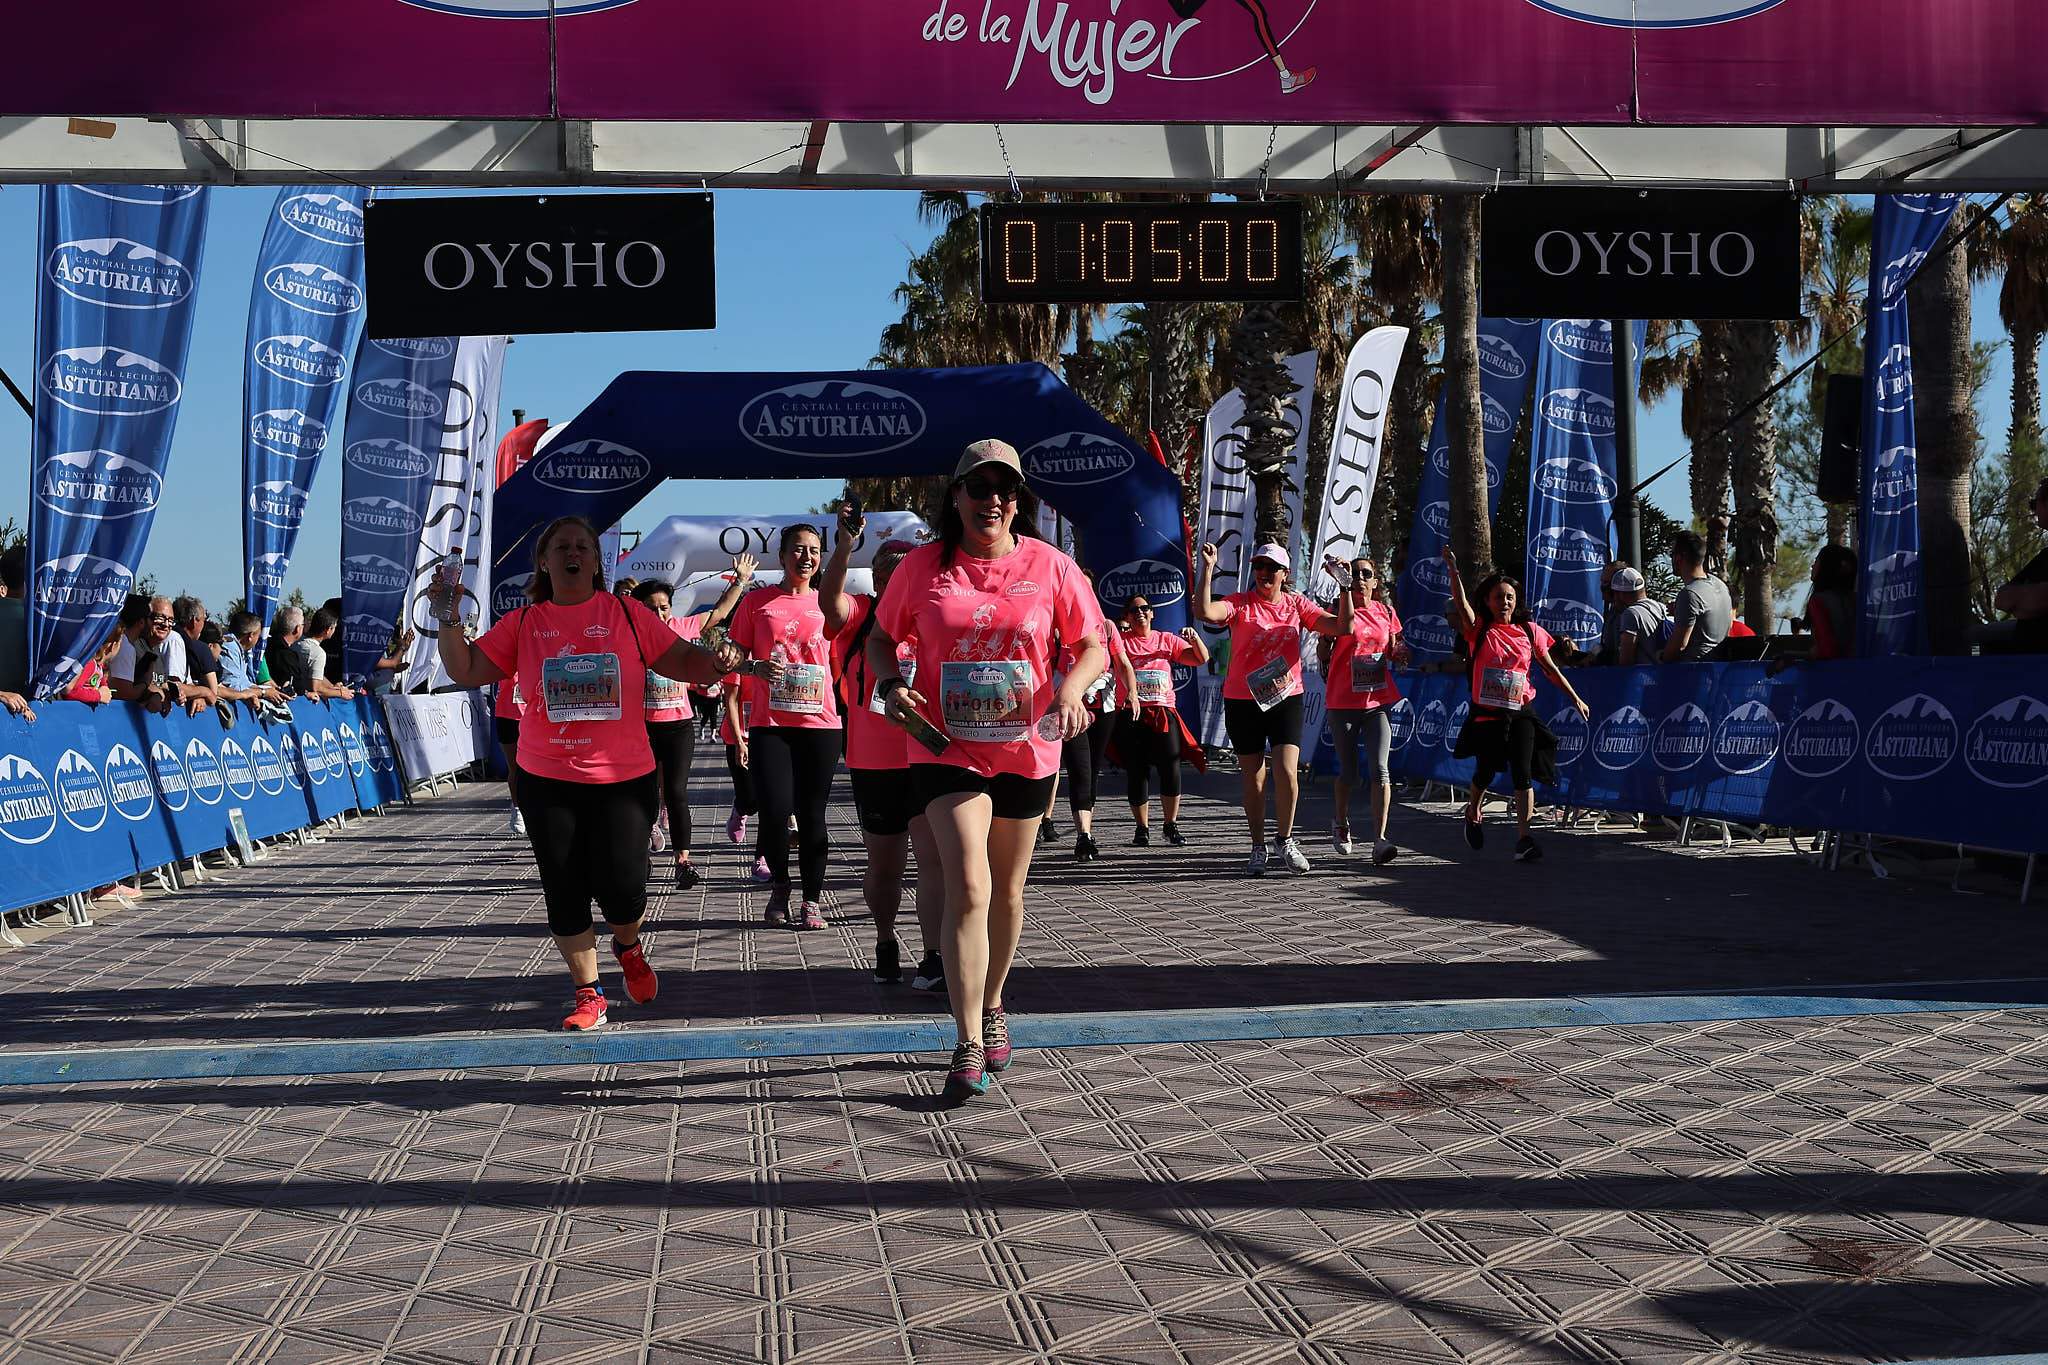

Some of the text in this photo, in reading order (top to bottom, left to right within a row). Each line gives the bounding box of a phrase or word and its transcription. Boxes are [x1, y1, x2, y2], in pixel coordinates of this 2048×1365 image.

[922, 0, 1201, 104] de la Mujer
[76, 255, 180, 277] CENTRAL LECHERA
[424, 240, 666, 290] OYSHO
[1535, 230, 1757, 277] OYSHO
[53, 254, 183, 297] ASTURIANA
[271, 272, 357, 309] ASTURIANA
[1553, 326, 1613, 355] ASTURIA
[260, 345, 341, 379] ASTURIANA
[49, 362, 169, 402] ASTURIANA
[362, 387, 436, 414] ASTURIANA
[782, 401, 906, 411] CENTRAL LECHERA
[1548, 398, 1615, 428] ASTURIAN
[753, 405, 913, 437] ASTURIANA
[351, 447, 425, 473] ASTURIANA
[539, 460, 641, 480] ASTURIANA
[1029, 454, 1129, 473] ASTURIANA
[1318, 369, 1384, 580] YSHO
[41, 469, 154, 505] ASTURIANA
[343, 505, 415, 532] ASTURIANA
[631, 561, 675, 571] OYSHO
[35, 576, 128, 605] ASTURIANA
[938, 587, 976, 597] OYSHO
[1105, 580, 1182, 598] ASTURIANA
[970, 673, 1004, 681] ASTURIANA
[1656, 728, 1705, 753] ASTURIANA
[1716, 727, 1773, 755] ASTURIANA
[1788, 727, 1851, 756] ASTURIANA
[1870, 726, 1949, 758] ASTURIANA
[1970, 728, 2048, 766] ASTURIAN
[61, 782, 105, 813] ASTURIANA
[110, 774, 152, 804] ASTURIANA
